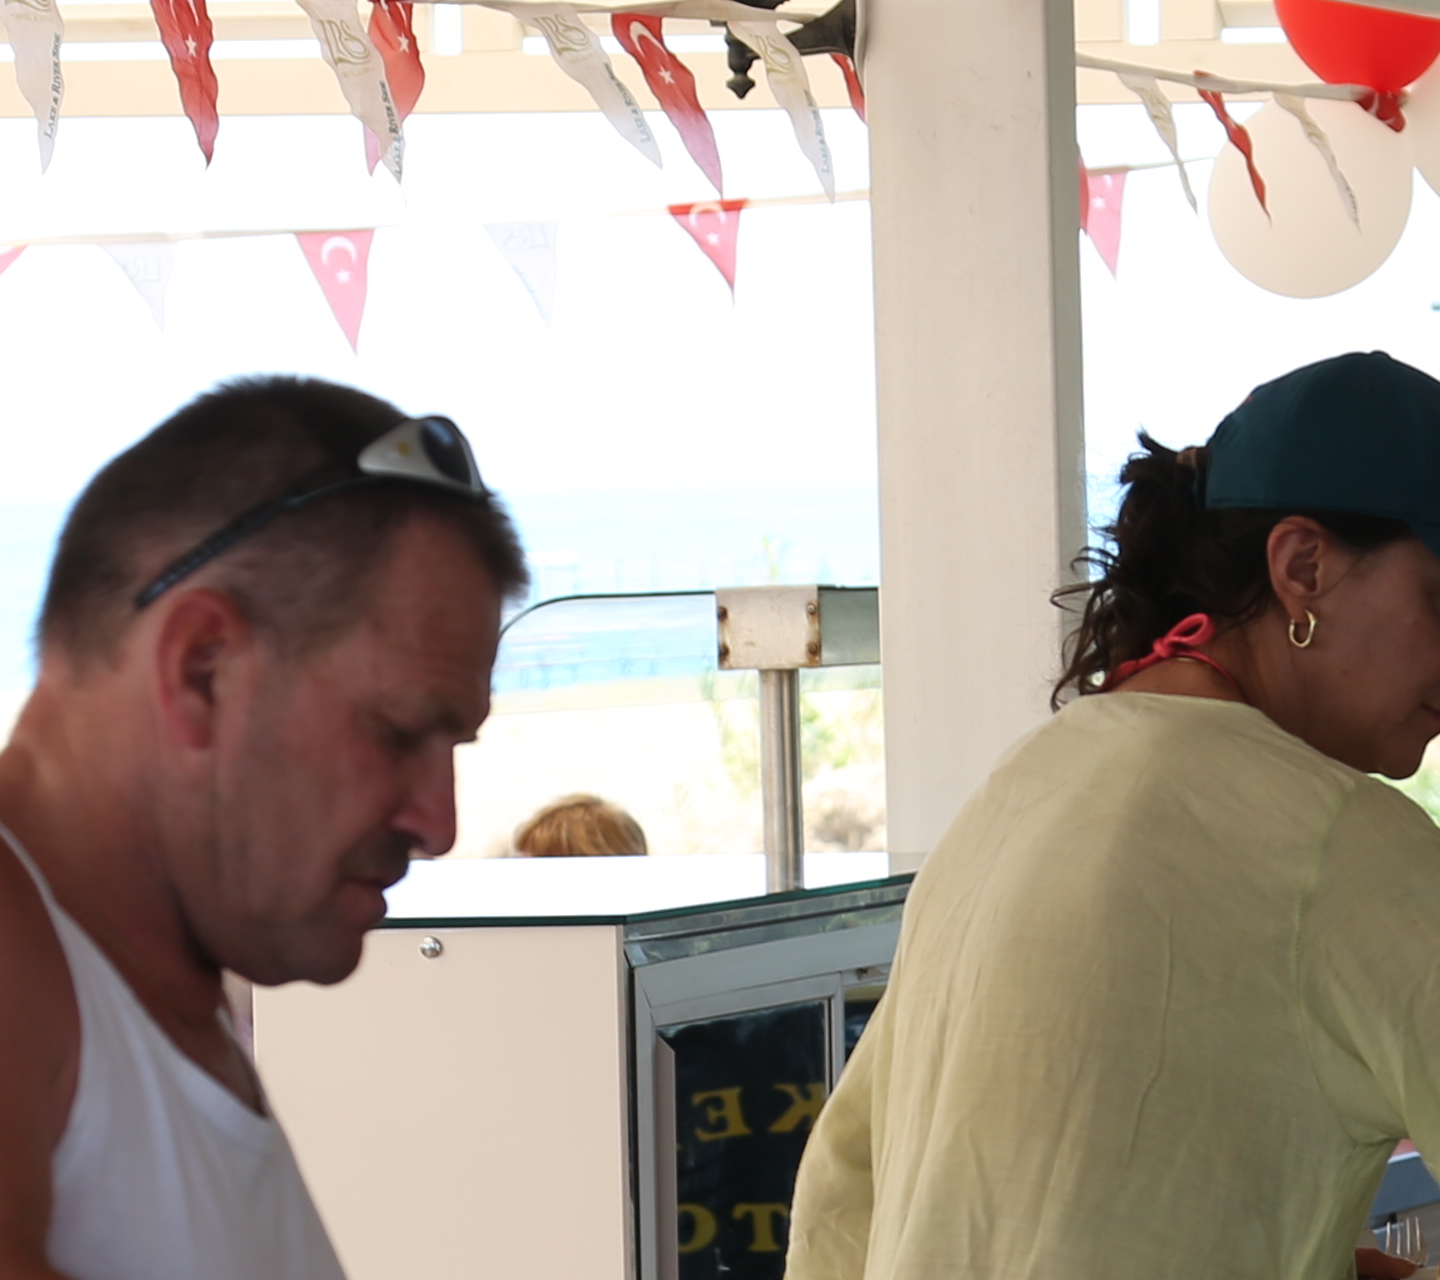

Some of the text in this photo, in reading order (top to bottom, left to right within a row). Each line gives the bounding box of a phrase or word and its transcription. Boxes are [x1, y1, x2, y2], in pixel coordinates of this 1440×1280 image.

[319, 19, 373, 67] LRS
[50, 59, 62, 96] RIVER
[43, 109, 59, 140] LAKE
